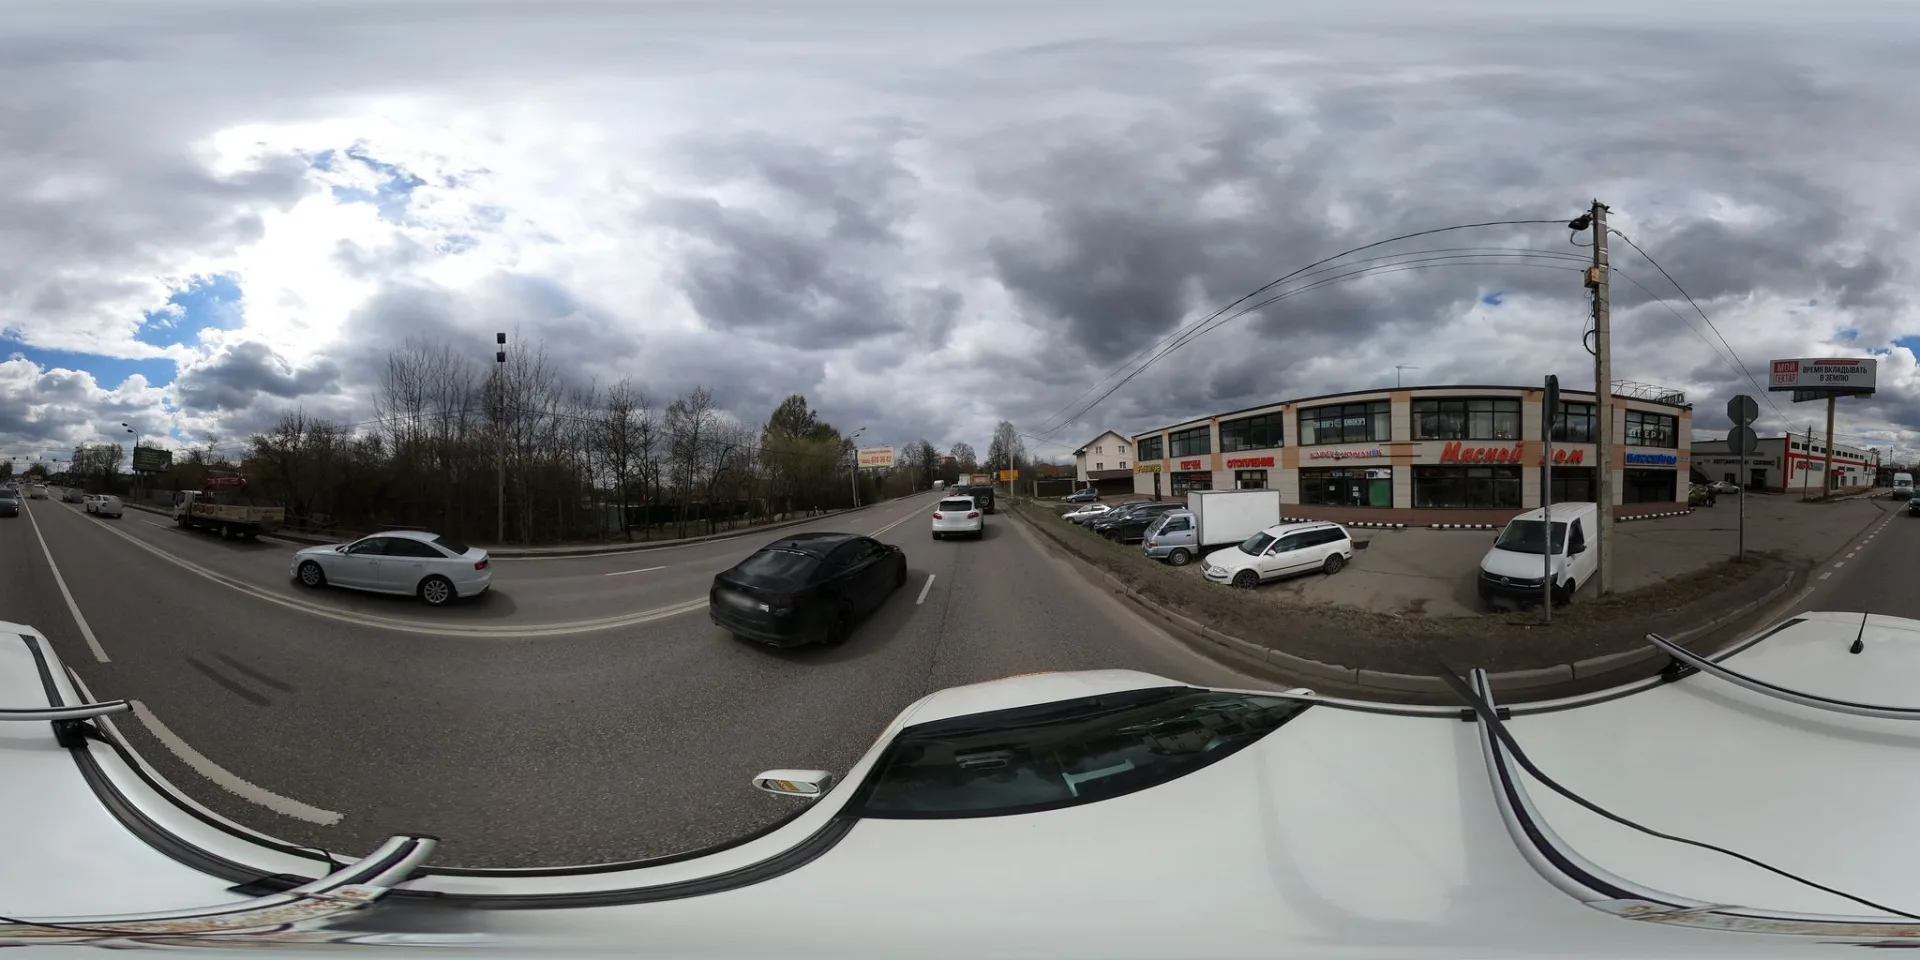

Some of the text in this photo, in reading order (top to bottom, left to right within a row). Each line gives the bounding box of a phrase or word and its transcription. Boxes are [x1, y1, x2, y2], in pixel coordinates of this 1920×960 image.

[1802, 366, 1868, 374] ВРЕМЯ ВКЛАДЫВАТЬ
[1819, 374, 1849, 382] В ЗЕМЛЮ
[1440, 441, 1526, 464] Мясной
[1180, 459, 1201, 470] ПЕЧИ
[1226, 456, 1275, 469] ОТОПЛЕНИЕ
